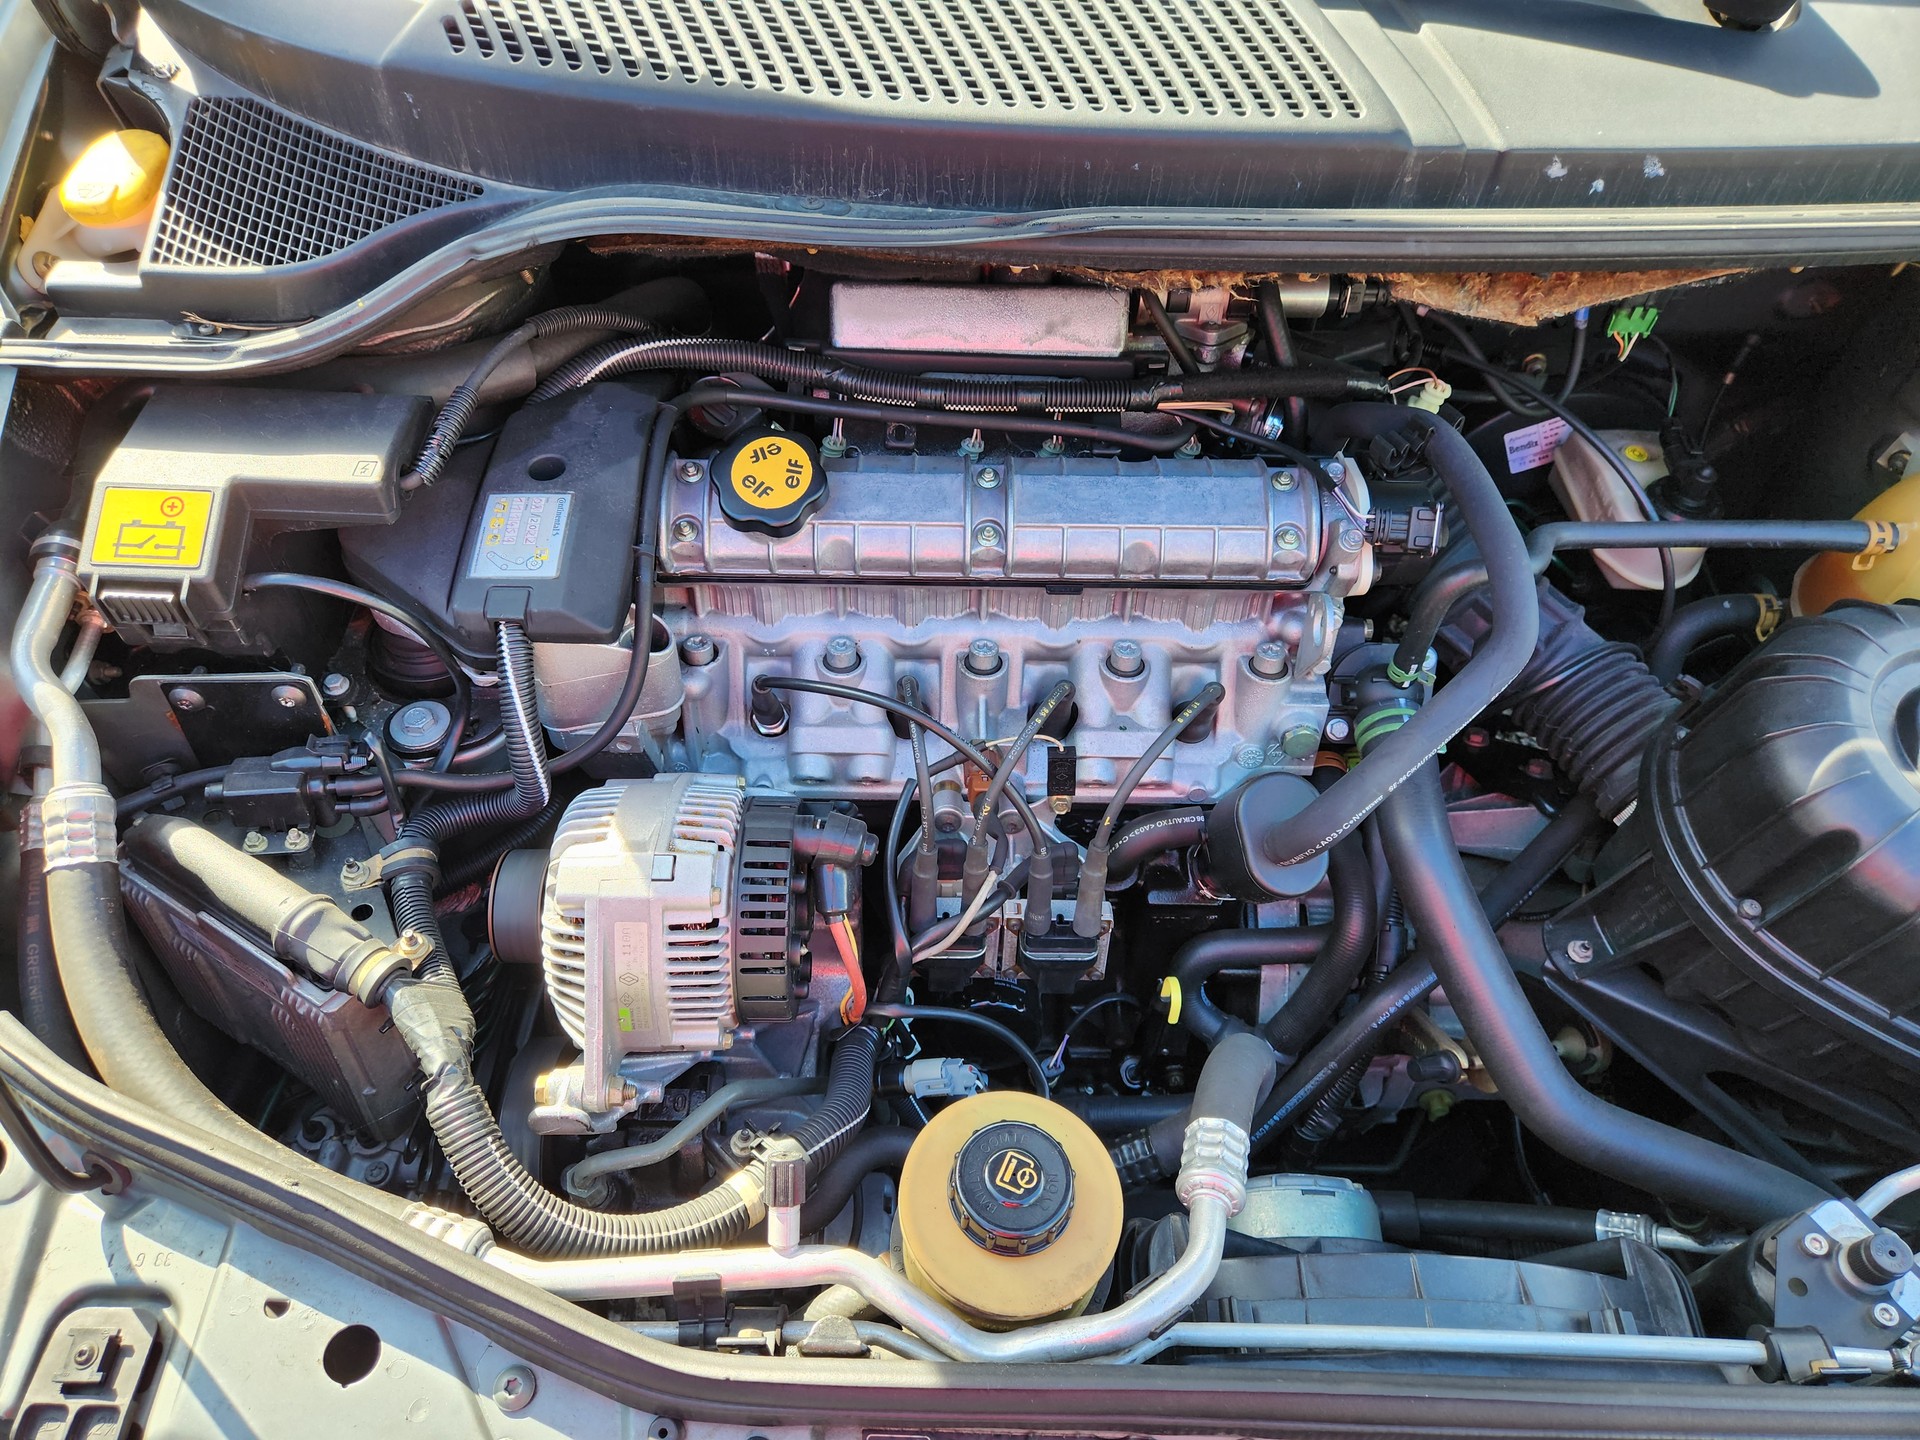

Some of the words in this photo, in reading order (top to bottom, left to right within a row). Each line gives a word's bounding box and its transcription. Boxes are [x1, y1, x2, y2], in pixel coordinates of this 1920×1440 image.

[750, 443, 782, 464] elf
[1508, 441, 1539, 454] Bendix
[785, 459, 803, 489] elf
[742, 475, 774, 498] elf
[553, 497, 566, 531] Continental
[1155, 815, 1195, 827] CIKAUTXO
